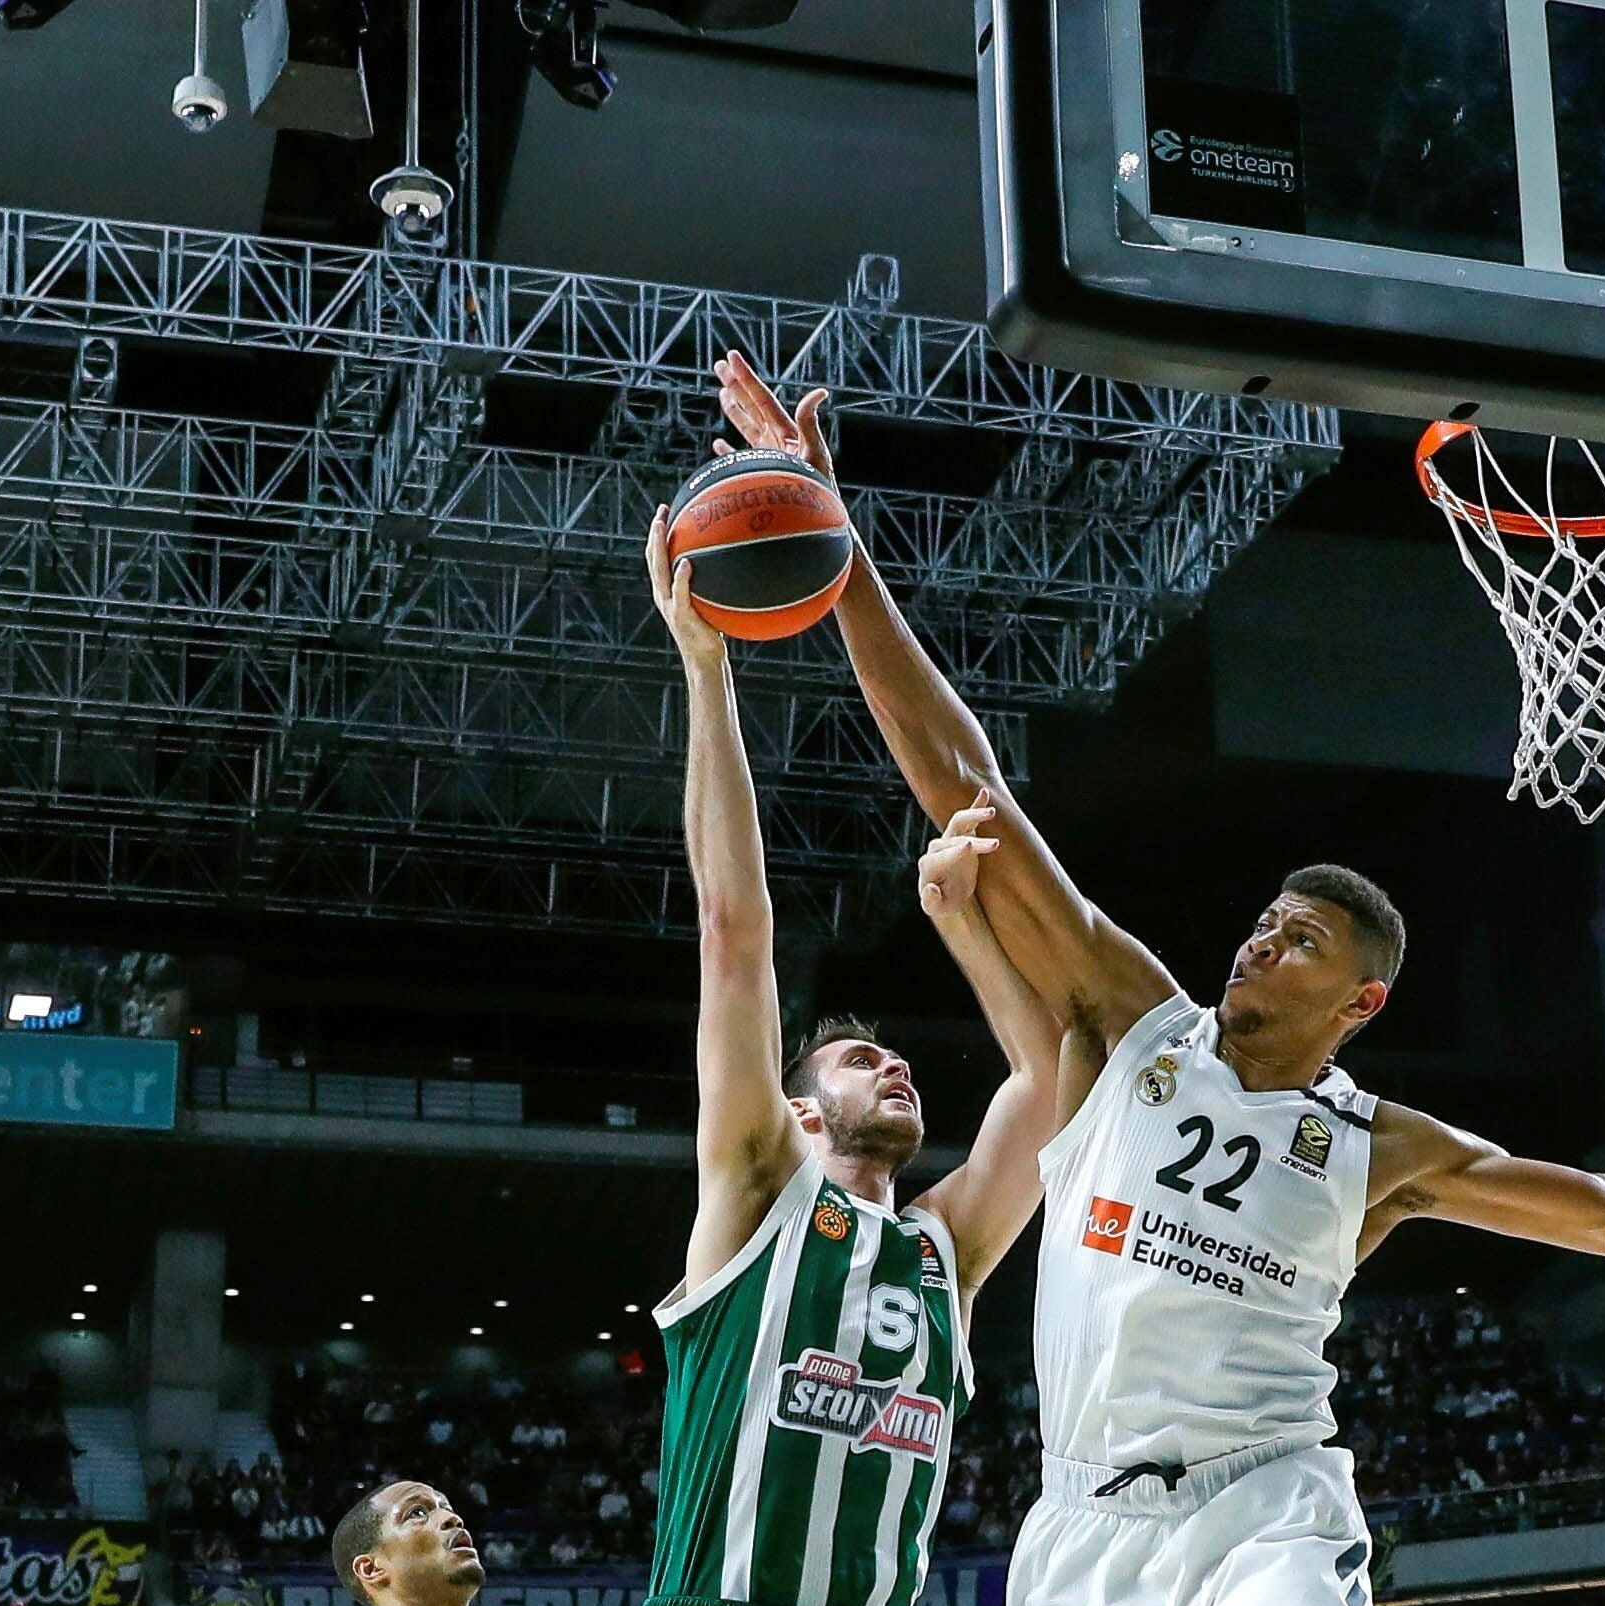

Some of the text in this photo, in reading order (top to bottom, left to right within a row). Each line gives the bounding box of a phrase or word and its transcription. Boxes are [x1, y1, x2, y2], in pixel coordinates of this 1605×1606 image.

[1190, 149, 1294, 177] oneteam
[1156, 1115, 1262, 1213] 22
[1132, 1238, 1244, 1297] Europea
[1141, 1210, 1298, 1289] Universidad
[866, 1282, 921, 1352] 6
[808, 1358, 851, 1381] pame
